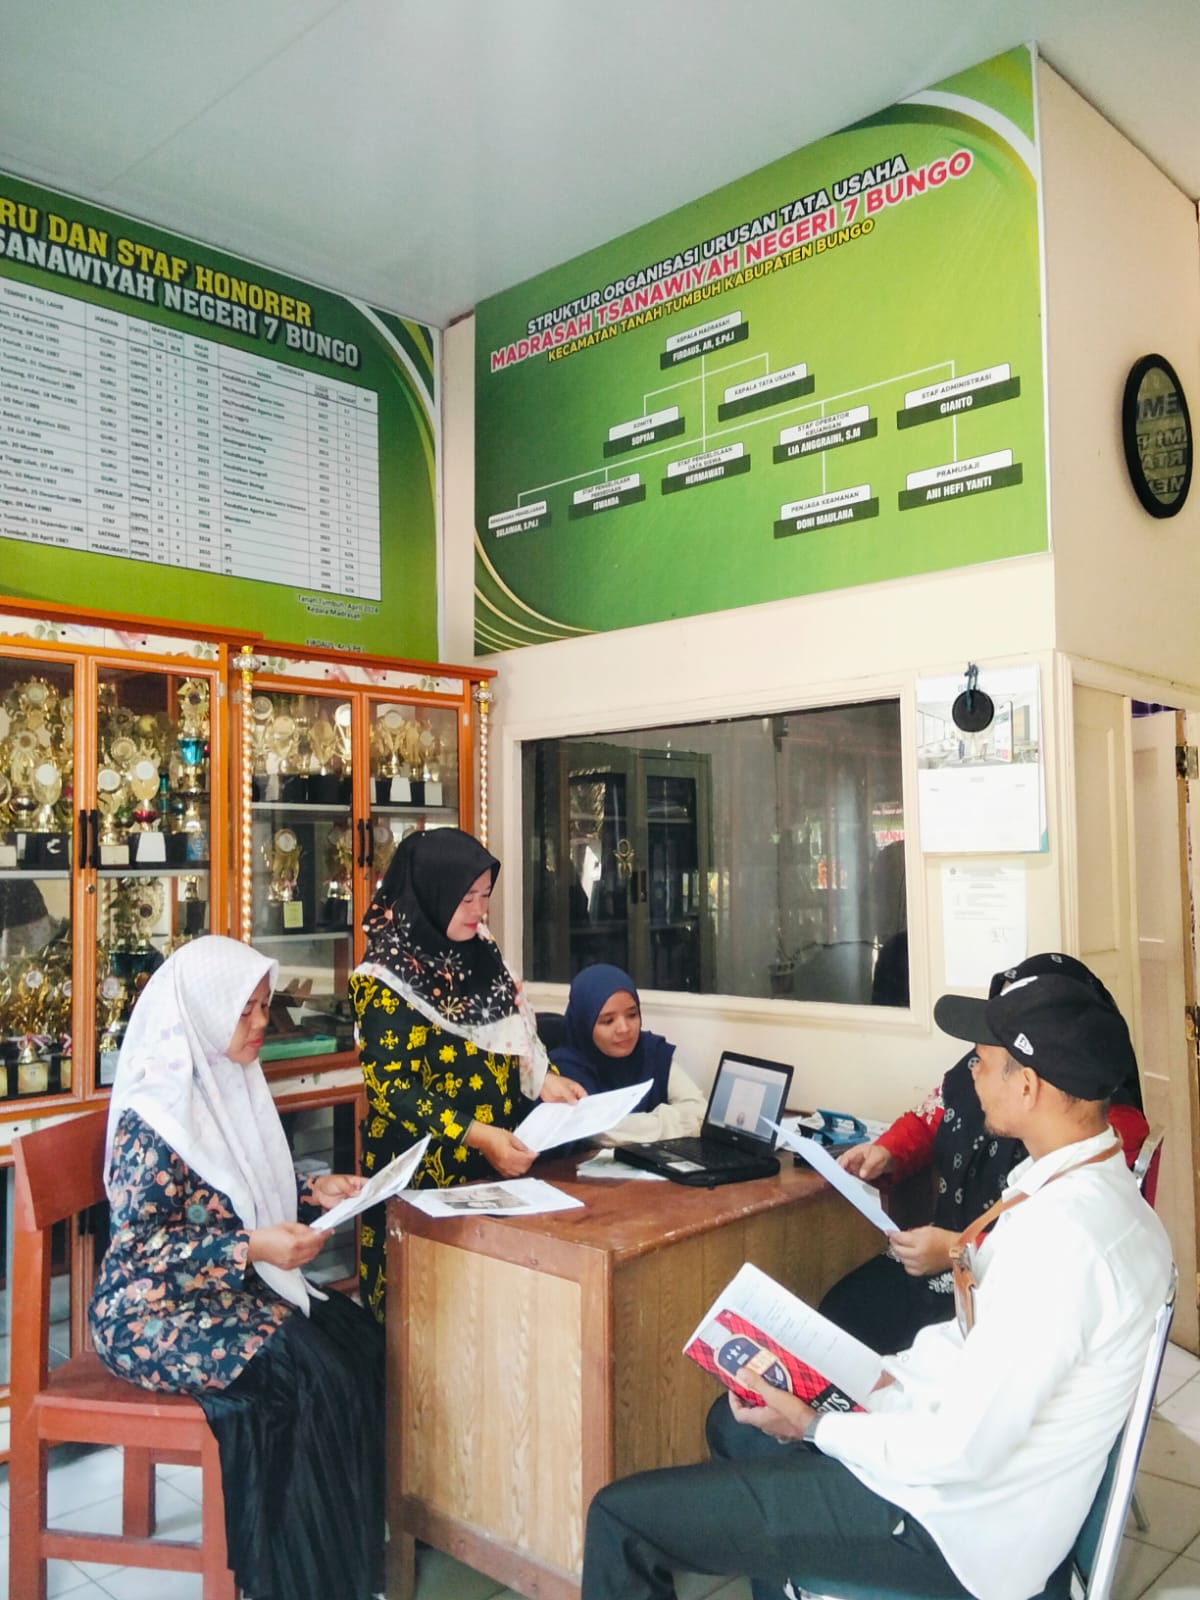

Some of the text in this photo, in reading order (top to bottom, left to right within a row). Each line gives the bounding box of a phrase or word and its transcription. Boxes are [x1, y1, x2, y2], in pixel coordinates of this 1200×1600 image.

[527, 153, 909, 336] STRUKTUR ORGANISASI URUSAN TATA USAHA
[48, 213, 109, 259] DAN
[117, 237, 188, 284] STAF
[194, 263, 313, 328] HONORER
[489, 150, 973, 373] MADRASAH TSANAWIYAH NEGERI 7 BUNGO
[547, 218, 875, 363] KECAMATAN TANAH TUMBUH KABUPATEN BUNGO
[164, 283, 257, 336] NEGERI
[263, 316, 278, 341] 7
[285, 324, 360, 369] BUNGO
[698, 318, 731, 337] MADRASAH
[734, 370, 796, 396] KEPALA TATA USAHA
[920, 373, 992, 399] STAF ADMINISTRASI
[939, 396, 973, 414] GIANTO
[797, 411, 850, 433] STAF OPERATOR
[805, 422, 842, 437] KEUANGAN
[787, 428, 861, 457] LIA ANGGRAINI, S.M
[935, 461, 980, 479] PRAMUSAJI
[926, 475, 993, 500] ANI HEFI YANTI
[790, 491, 860, 513] PENJAGA KEAMANAN
[796, 508, 853, 531] DONI MAULANA
